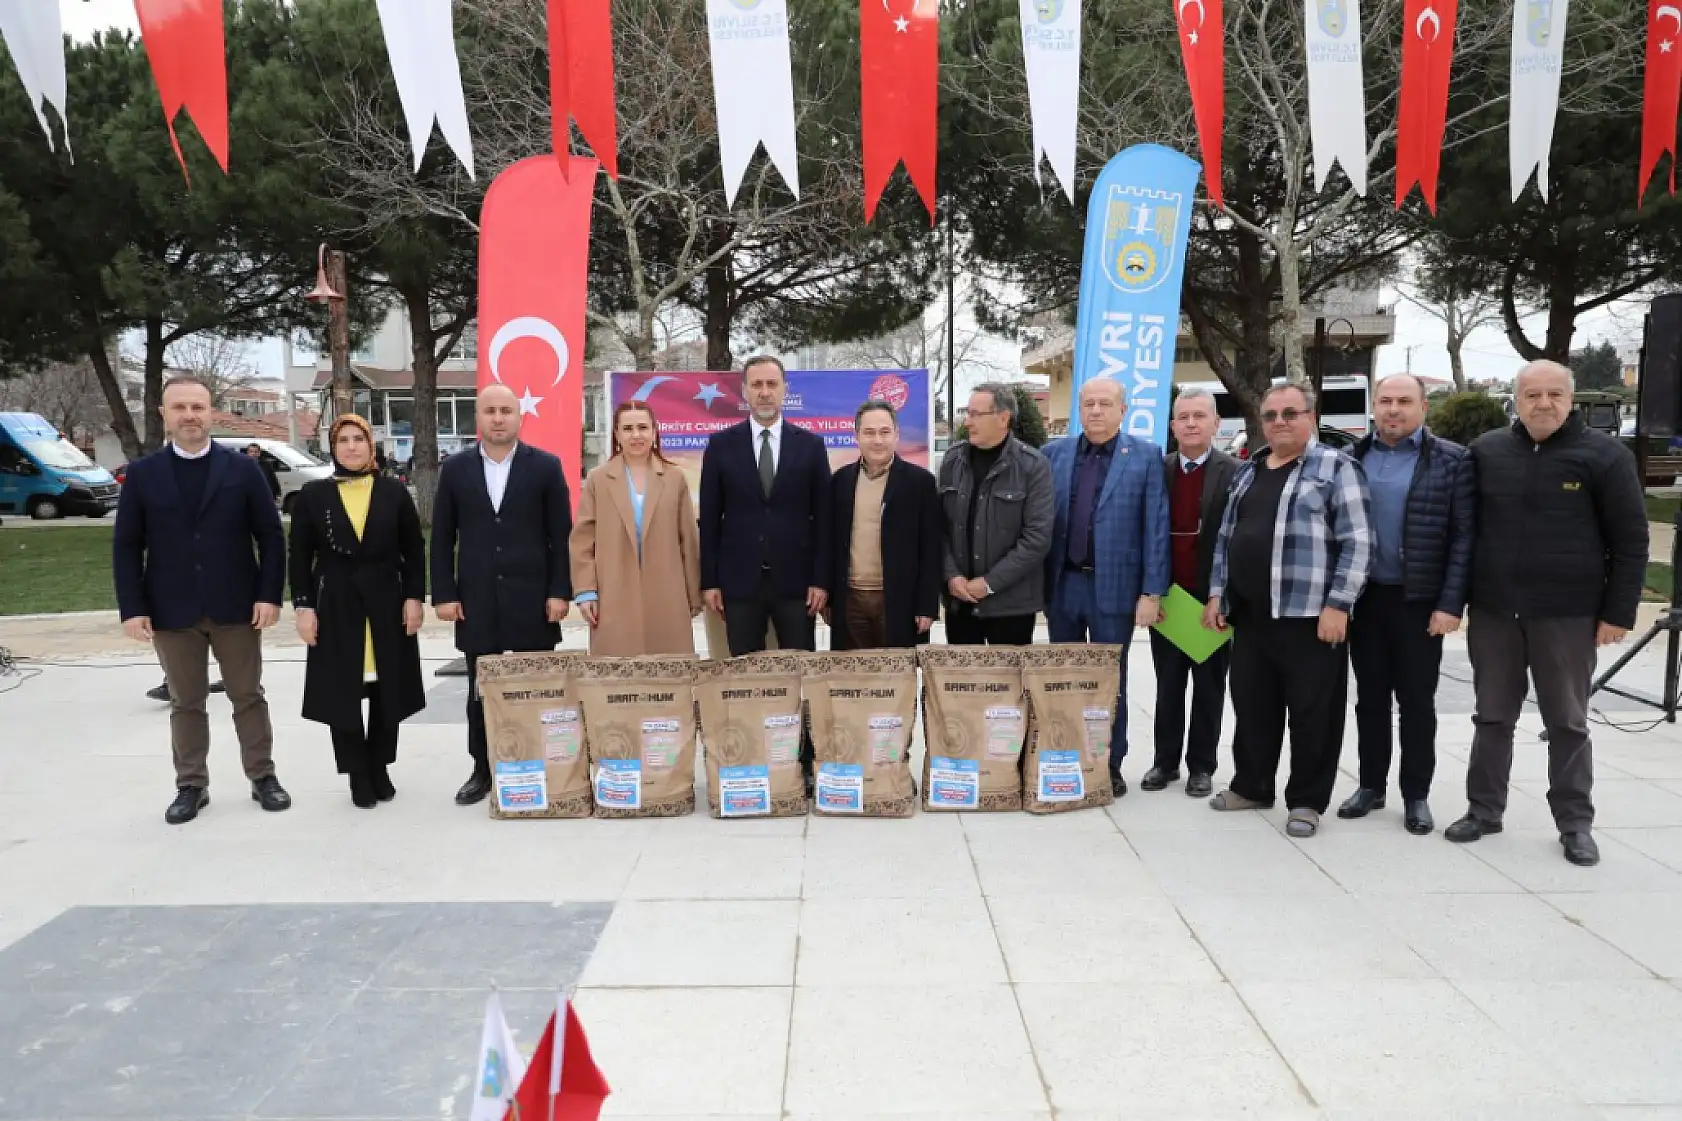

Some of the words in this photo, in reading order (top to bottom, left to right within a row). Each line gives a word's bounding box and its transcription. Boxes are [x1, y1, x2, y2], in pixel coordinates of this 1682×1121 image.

[1099, 311, 1133, 379] VRİ
[1128, 314, 1165, 437] DİYESİ
[695, 422, 732, 431] CUMH
[839, 421, 856, 430] ON
